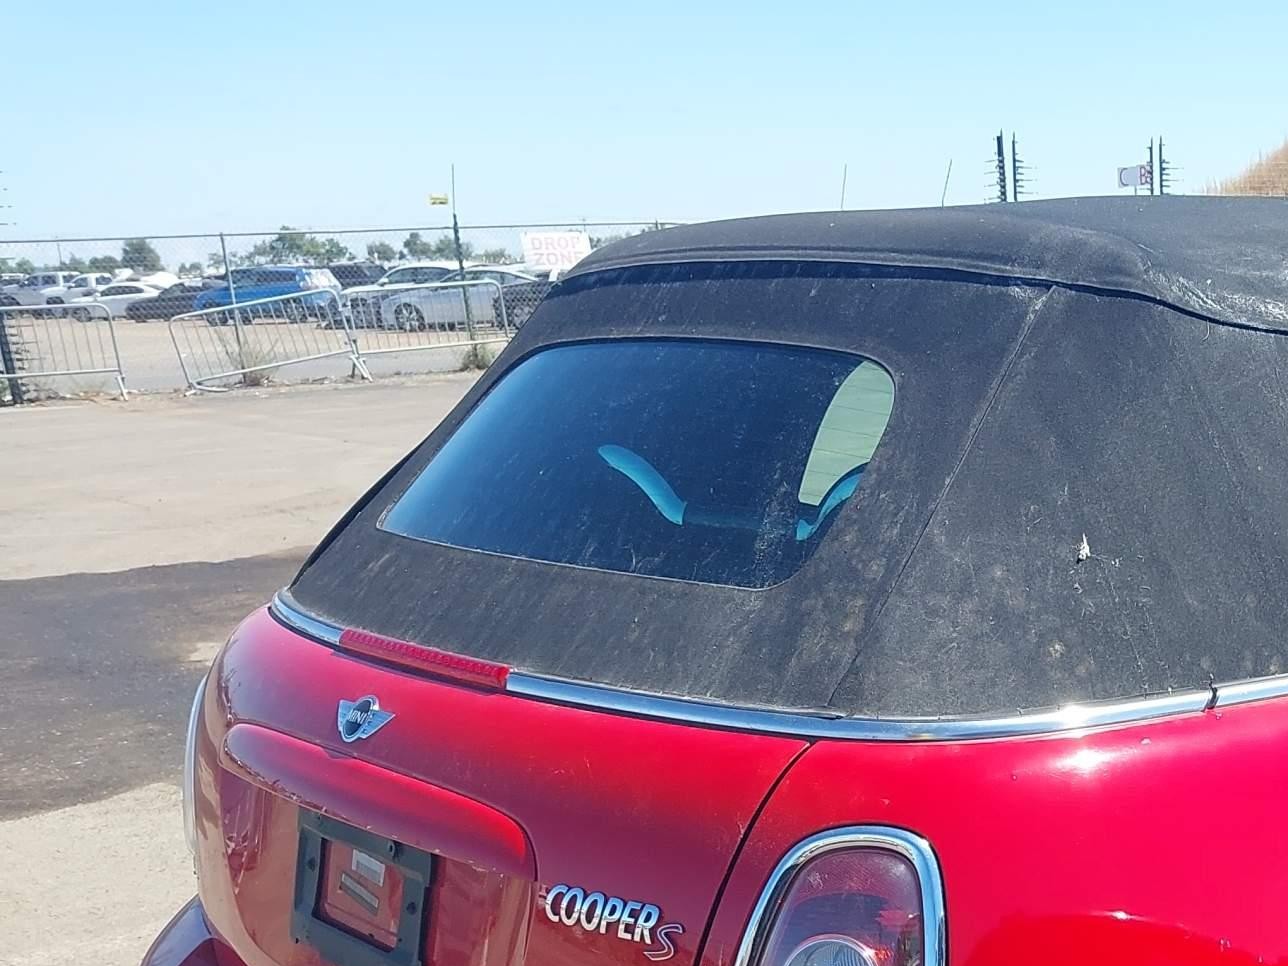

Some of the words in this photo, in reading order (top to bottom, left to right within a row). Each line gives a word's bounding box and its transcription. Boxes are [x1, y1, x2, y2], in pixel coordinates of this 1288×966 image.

[530, 236, 579, 250] DROP
[545, 883, 661, 944] COOPER
[643, 922, 685, 961] S
